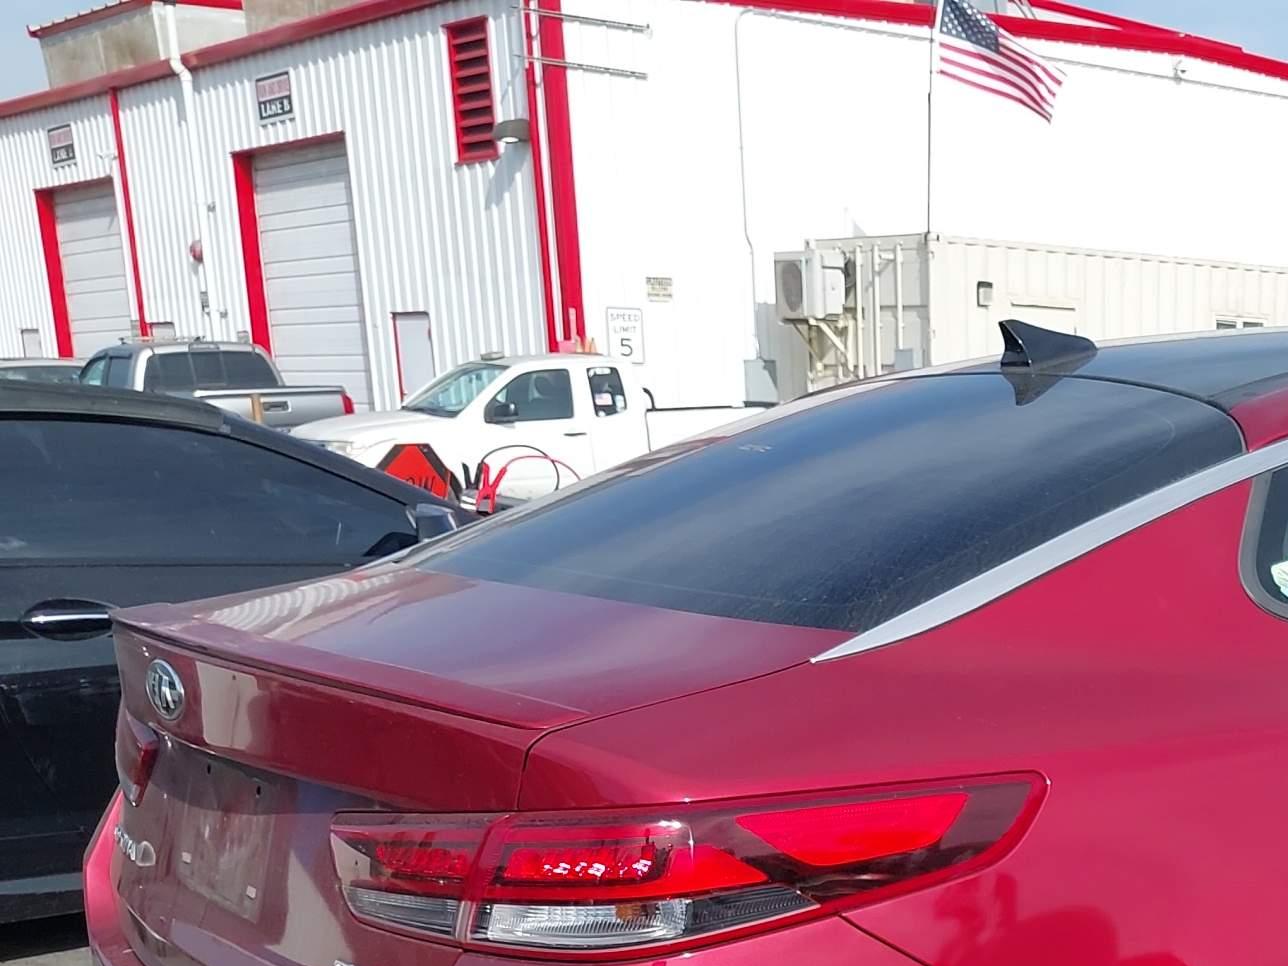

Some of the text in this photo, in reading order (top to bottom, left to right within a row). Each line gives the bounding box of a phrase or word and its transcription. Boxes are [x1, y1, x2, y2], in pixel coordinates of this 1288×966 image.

[261, 99, 283, 118] LANE
[610, 313, 640, 322] SPEED
[613, 325, 637, 334] LIMIT
[620, 338, 633, 357] 5
